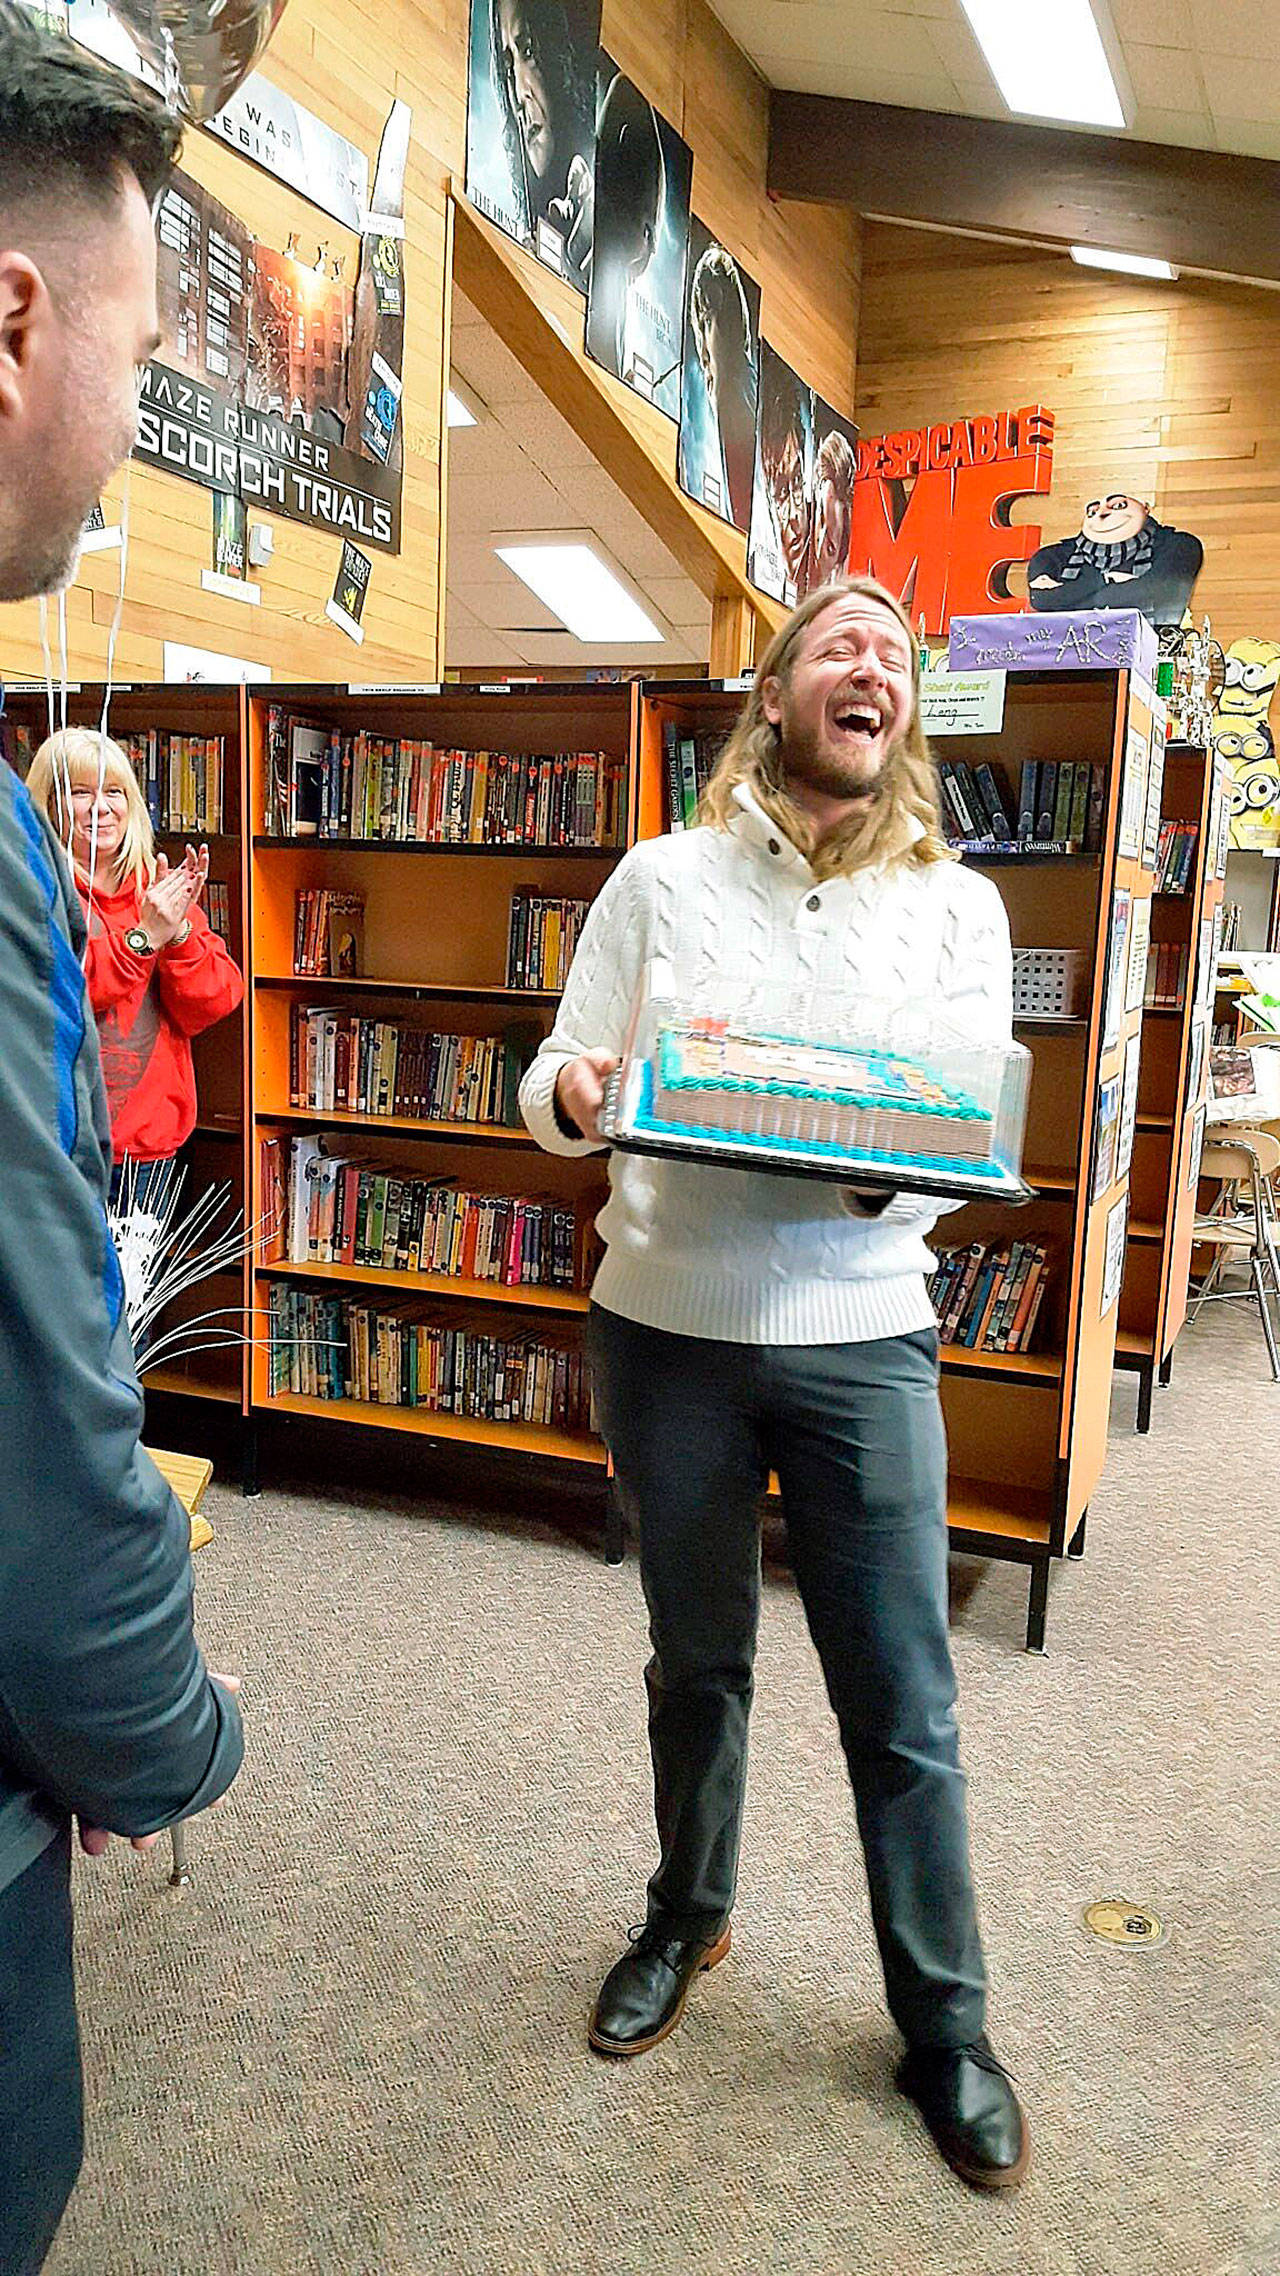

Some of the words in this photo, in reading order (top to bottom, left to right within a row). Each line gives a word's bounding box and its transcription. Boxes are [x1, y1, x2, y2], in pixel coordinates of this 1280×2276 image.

[246, 102, 291, 148] WAS
[136, 363, 213, 424] MAZE
[224, 406, 330, 472] RUNNER
[854, 404, 1055, 480] DESPICABLE
[135, 407, 286, 504] SCORCH
[291, 472, 392, 544] TRIALS
[848, 452, 1053, 636] ME
[1056, 621, 1110, 664] AR
